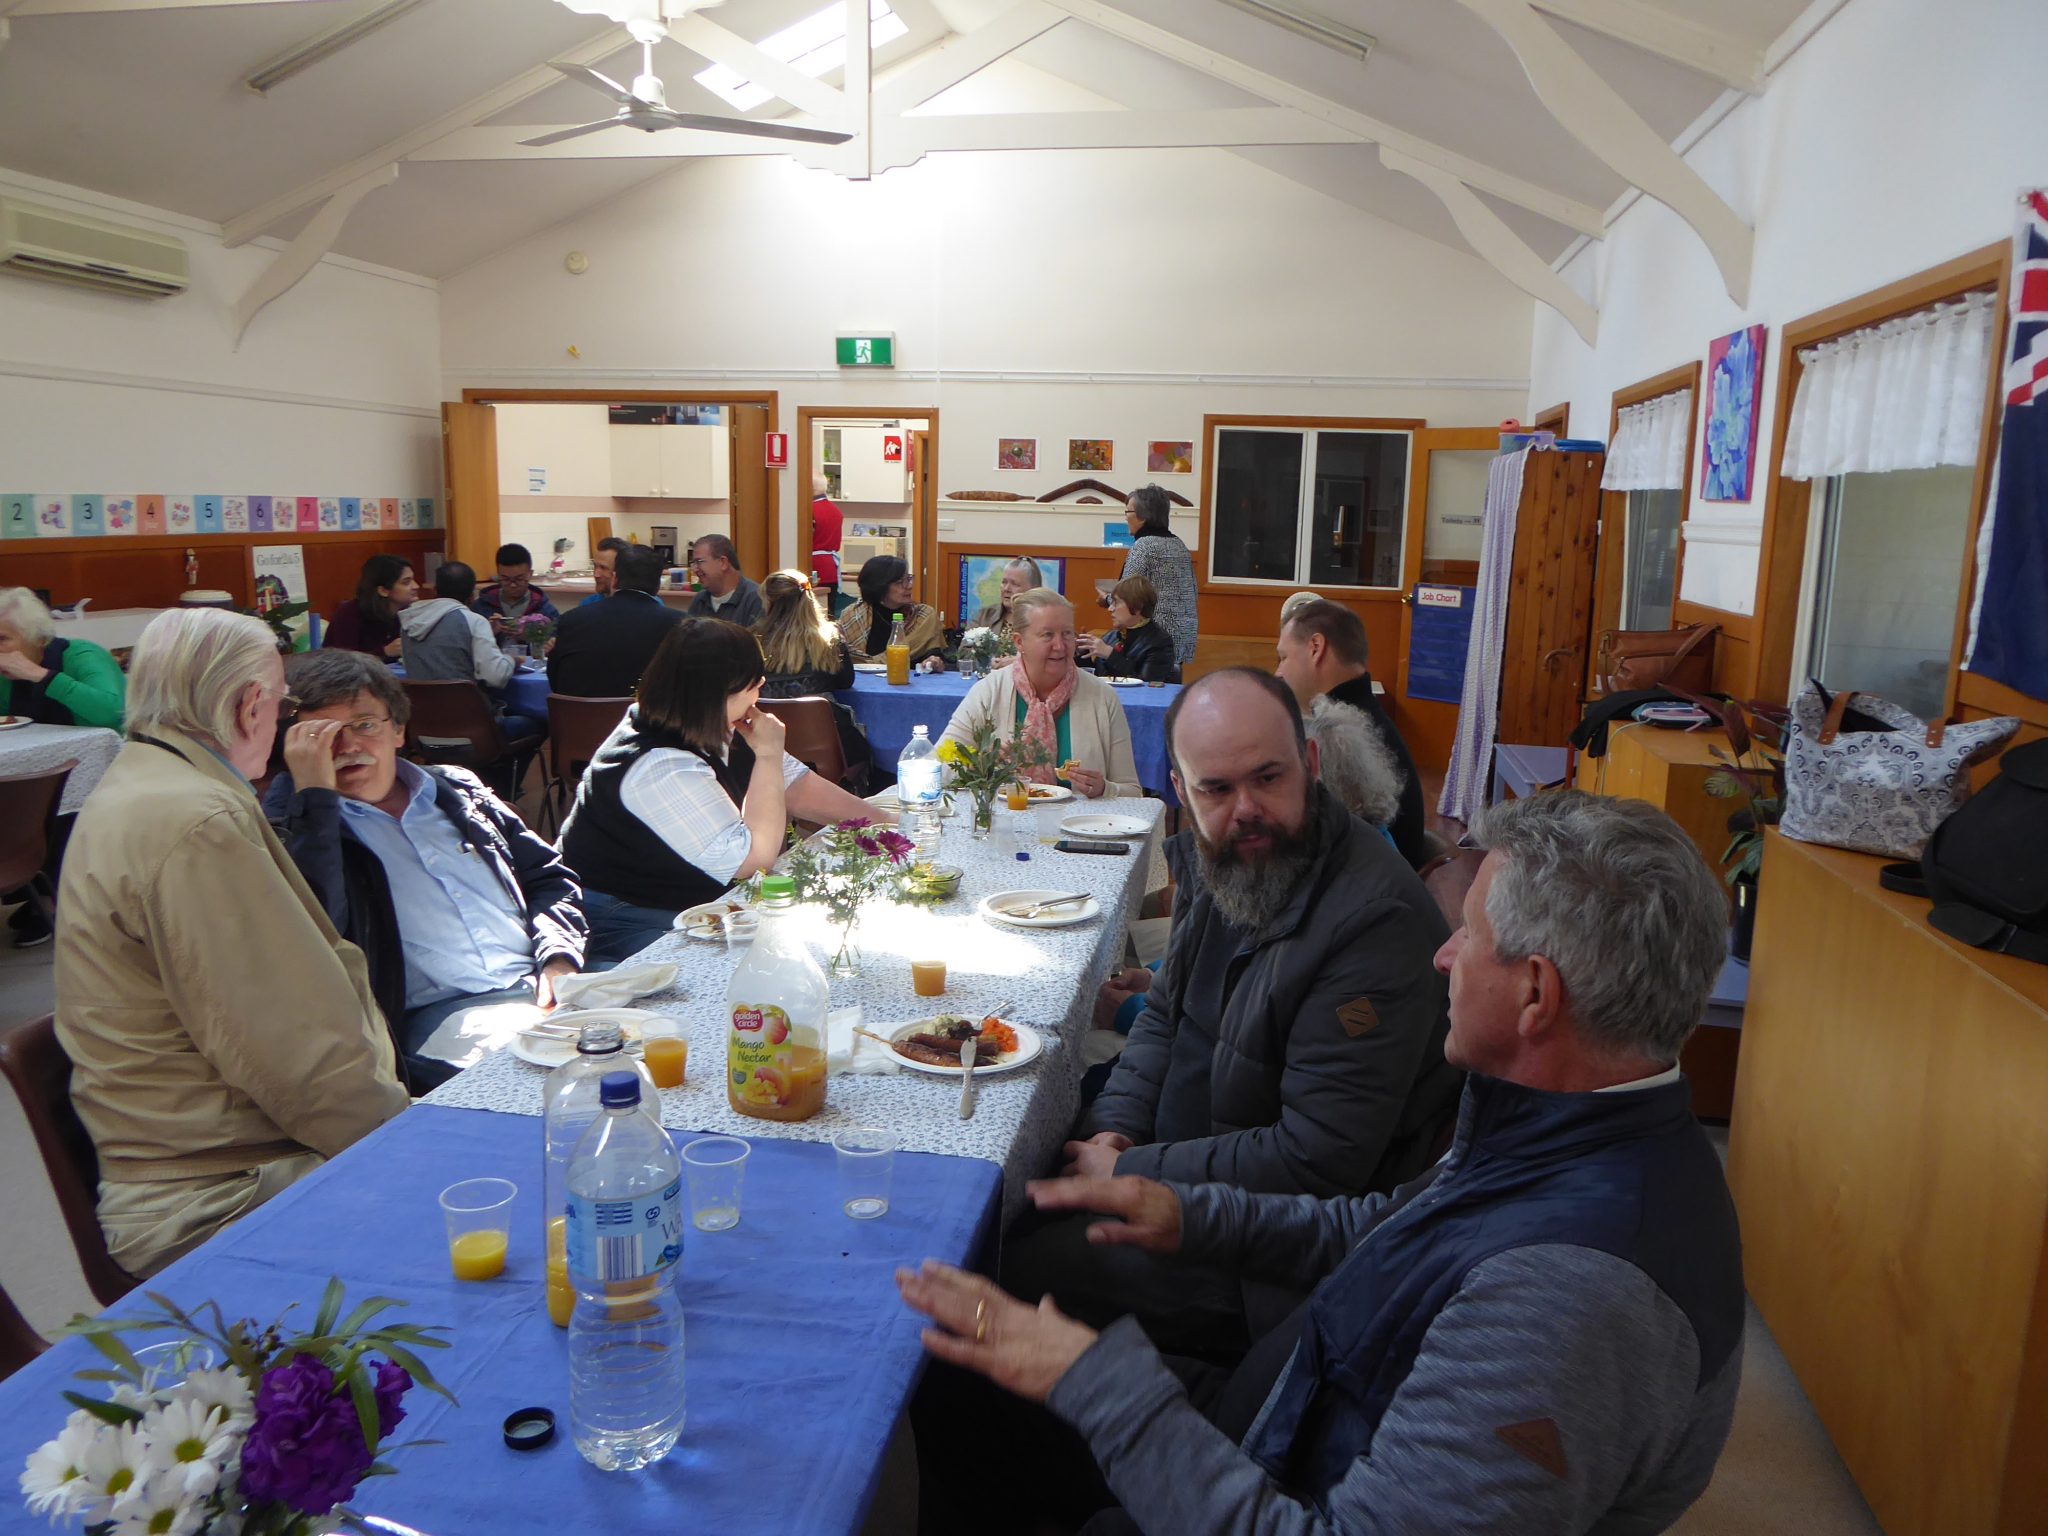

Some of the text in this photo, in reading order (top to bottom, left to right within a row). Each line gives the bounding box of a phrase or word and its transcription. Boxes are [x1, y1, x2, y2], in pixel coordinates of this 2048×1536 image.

[12, 502, 22, 521] 2
[83, 502, 94, 520] 3
[146, 502, 155, 518] 4
[204, 502, 214, 518] 5
[256, 503, 265, 518] 6
[303, 503, 311, 517] 7
[346, 504, 353, 518] 8
[386, 504, 393, 517] 9
[421, 504, 432, 517] 10
[960, 563, 968, 594] Australia
[961, 595, 967, 603] of
[1422, 592, 1457, 602] Job Chart
[735, 1012, 760, 1021] golden
[733, 1037, 765, 1052] Mango
[737, 1051, 772, 1062] Nectar
